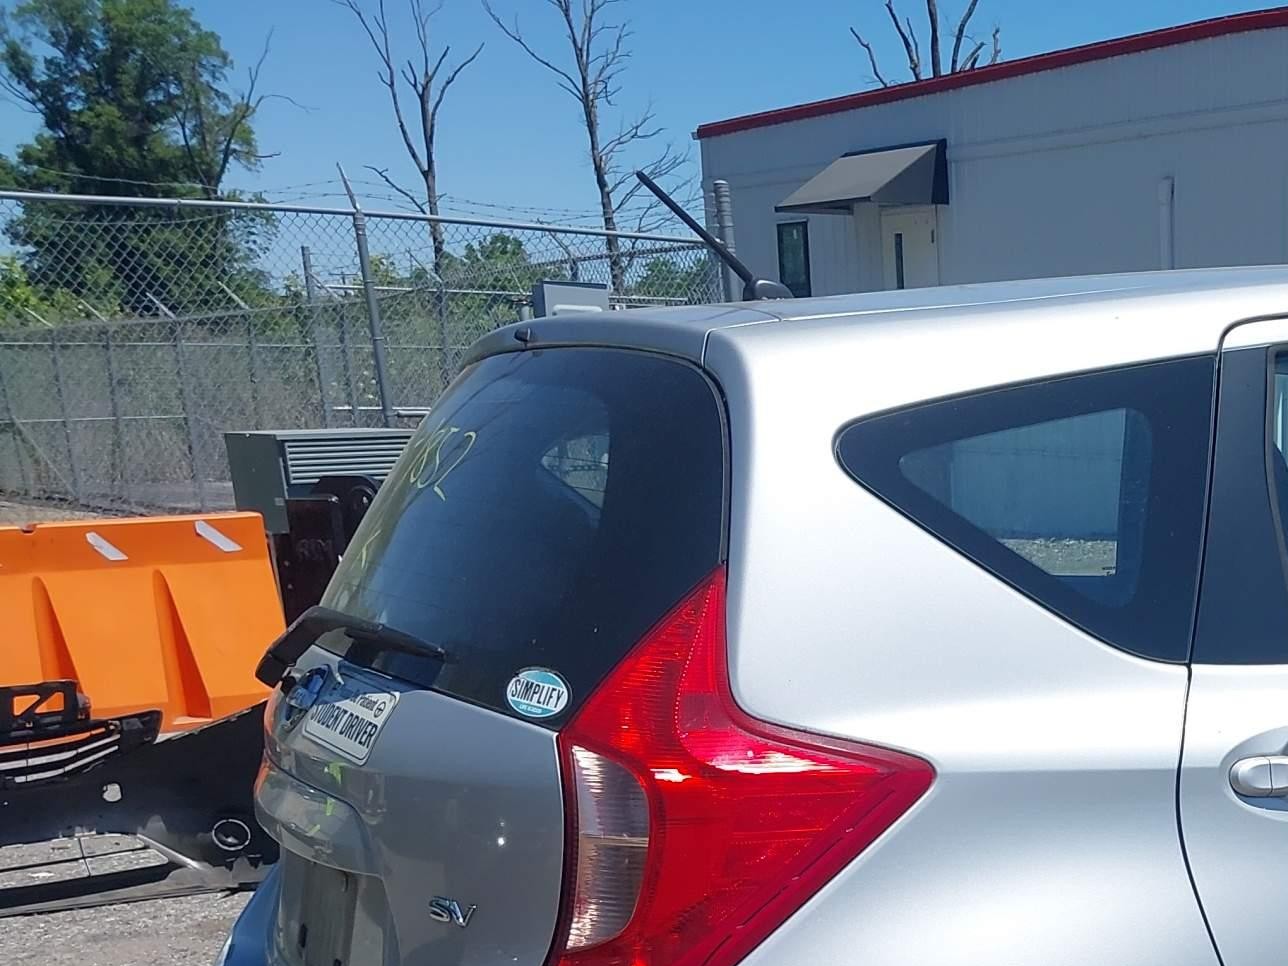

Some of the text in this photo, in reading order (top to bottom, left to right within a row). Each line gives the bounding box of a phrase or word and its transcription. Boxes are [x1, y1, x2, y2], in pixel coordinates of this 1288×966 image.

[511, 678, 565, 709] SIMPLIFY
[310, 703, 379, 749] STUDENT DRIVER
[429, 896, 477, 927] SV
